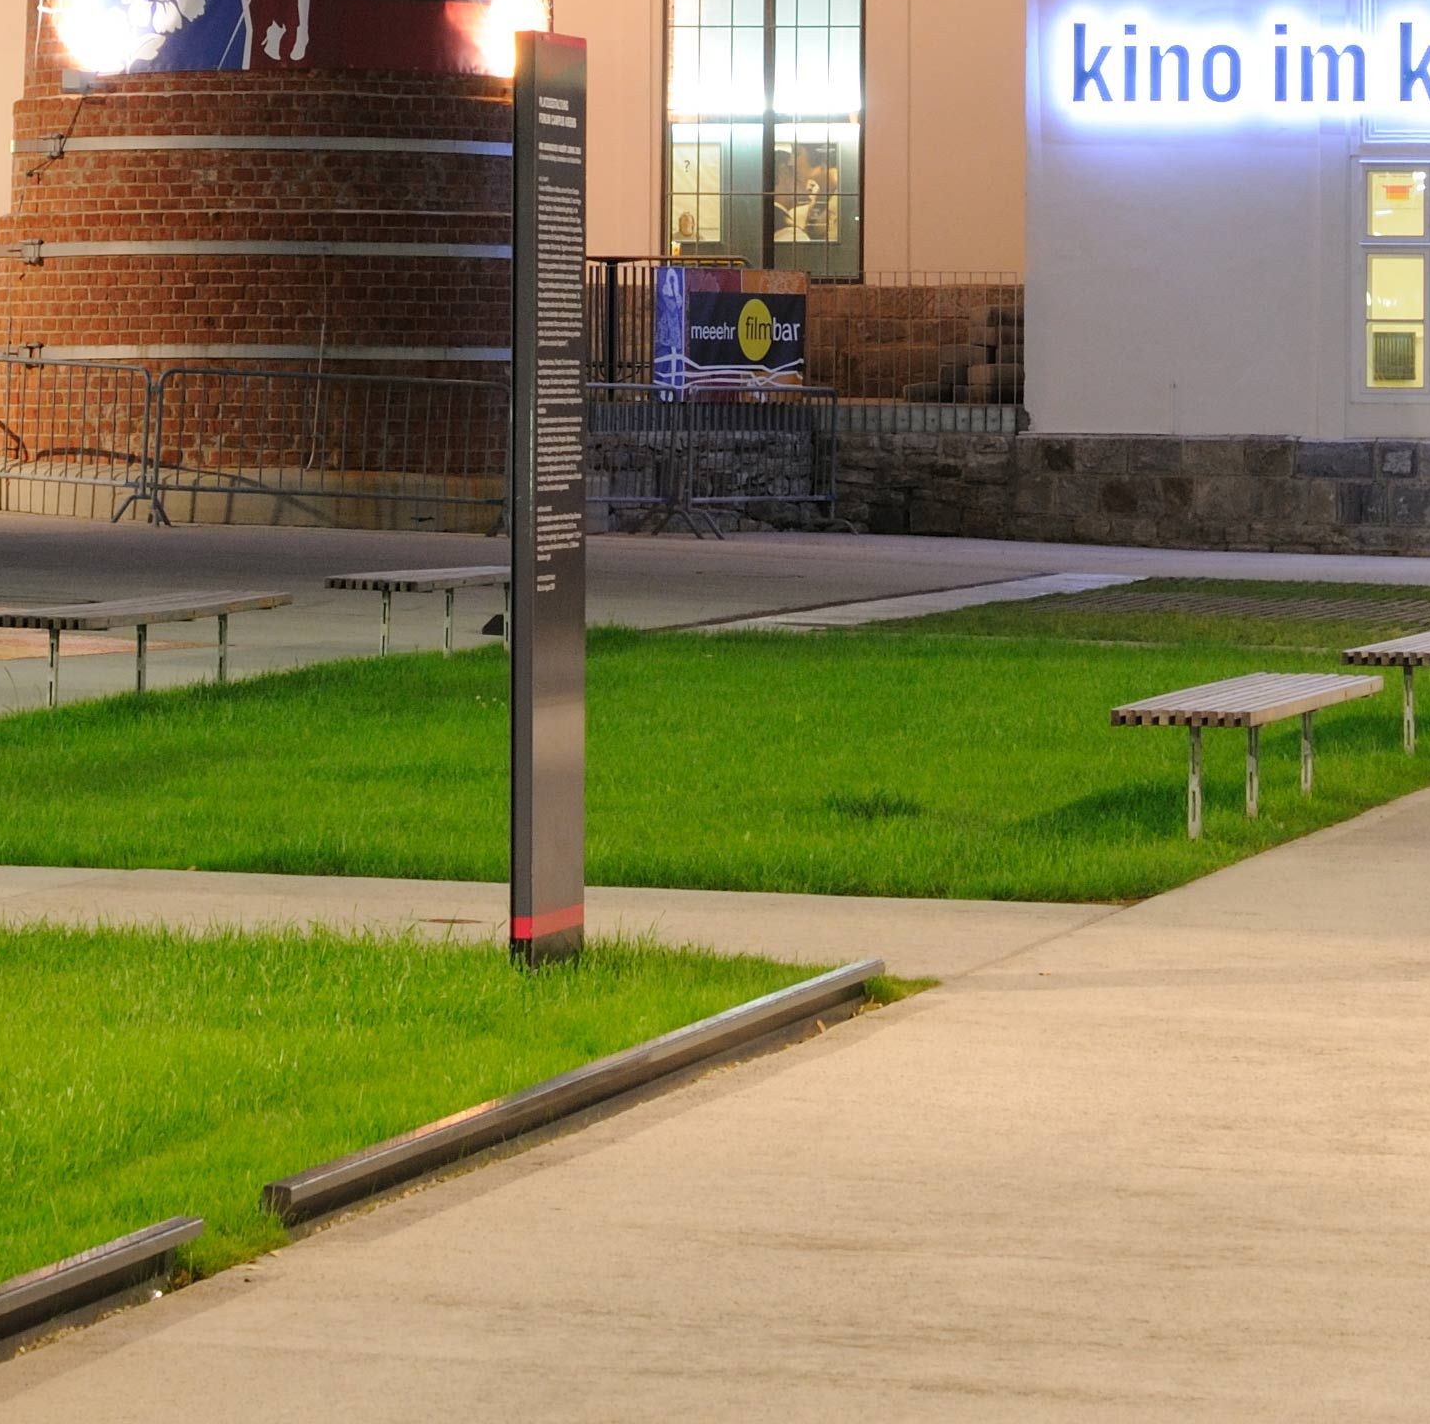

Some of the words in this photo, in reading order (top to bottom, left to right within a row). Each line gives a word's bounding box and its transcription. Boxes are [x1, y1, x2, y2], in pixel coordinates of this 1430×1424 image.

[1073, 23, 1241, 102] kino
[1275, 23, 1365, 102] im
[691, 322, 736, 340] meeehr
[746, 316, 801, 342] filmbar
